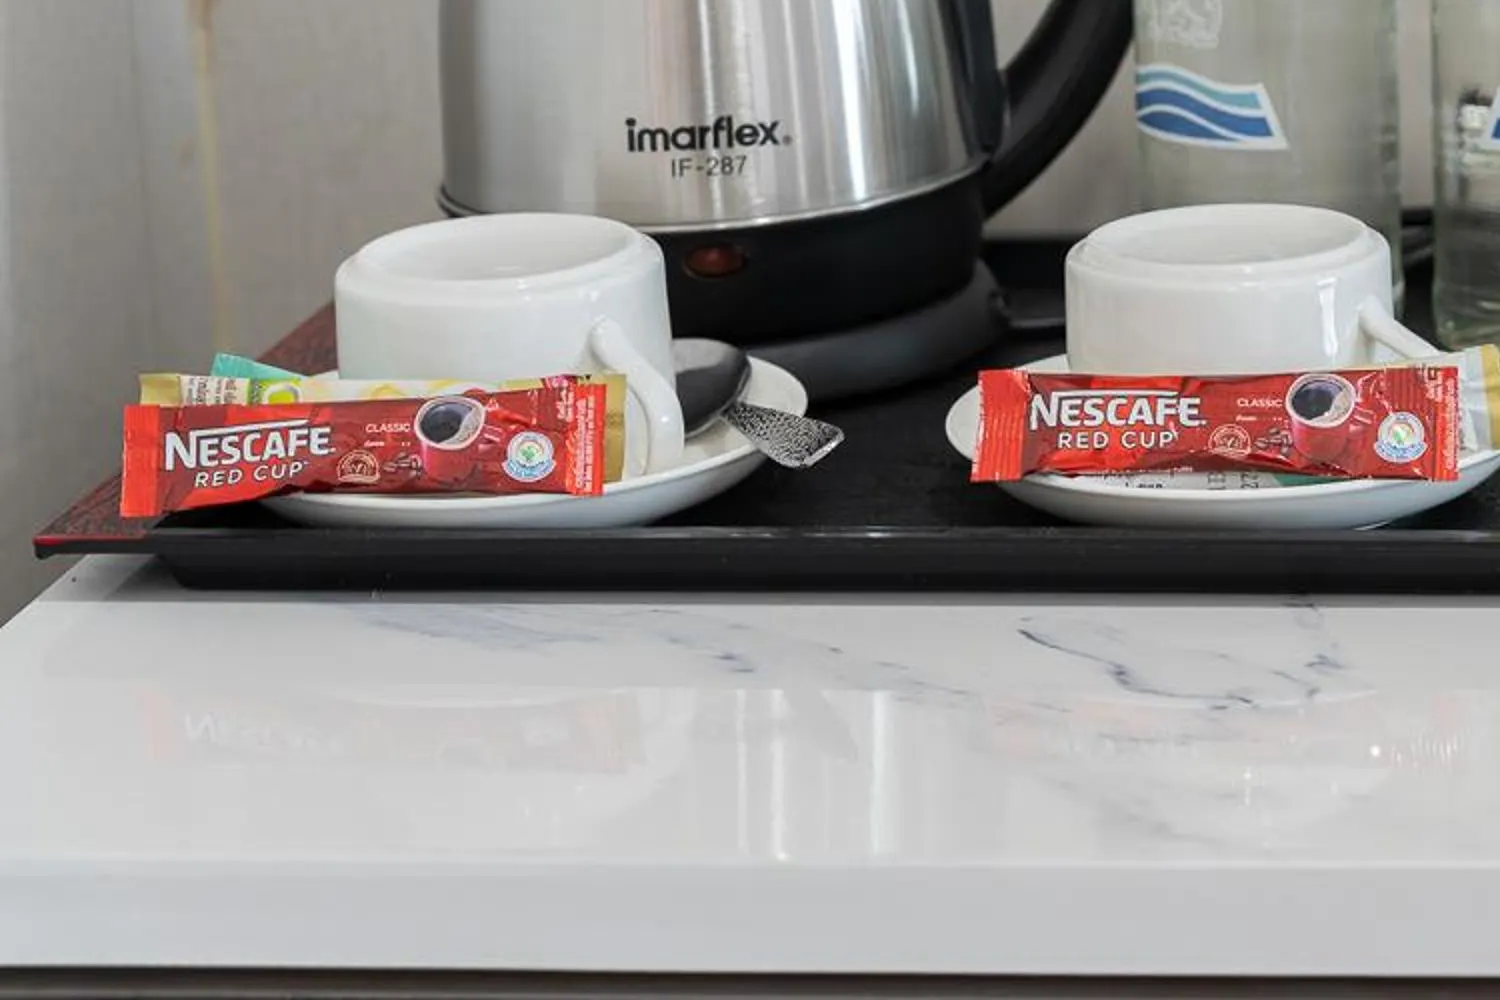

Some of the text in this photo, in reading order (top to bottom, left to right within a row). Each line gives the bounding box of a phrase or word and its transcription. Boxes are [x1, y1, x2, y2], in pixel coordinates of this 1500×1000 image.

[671, 155, 747, 178] IF-287
[1236, 397, 1284, 409] CLASSIC
[365, 422, 411, 433] CLASSIC
[1057, 431, 1174, 449] RED CUP
[194, 461, 303, 488] RED CUP
